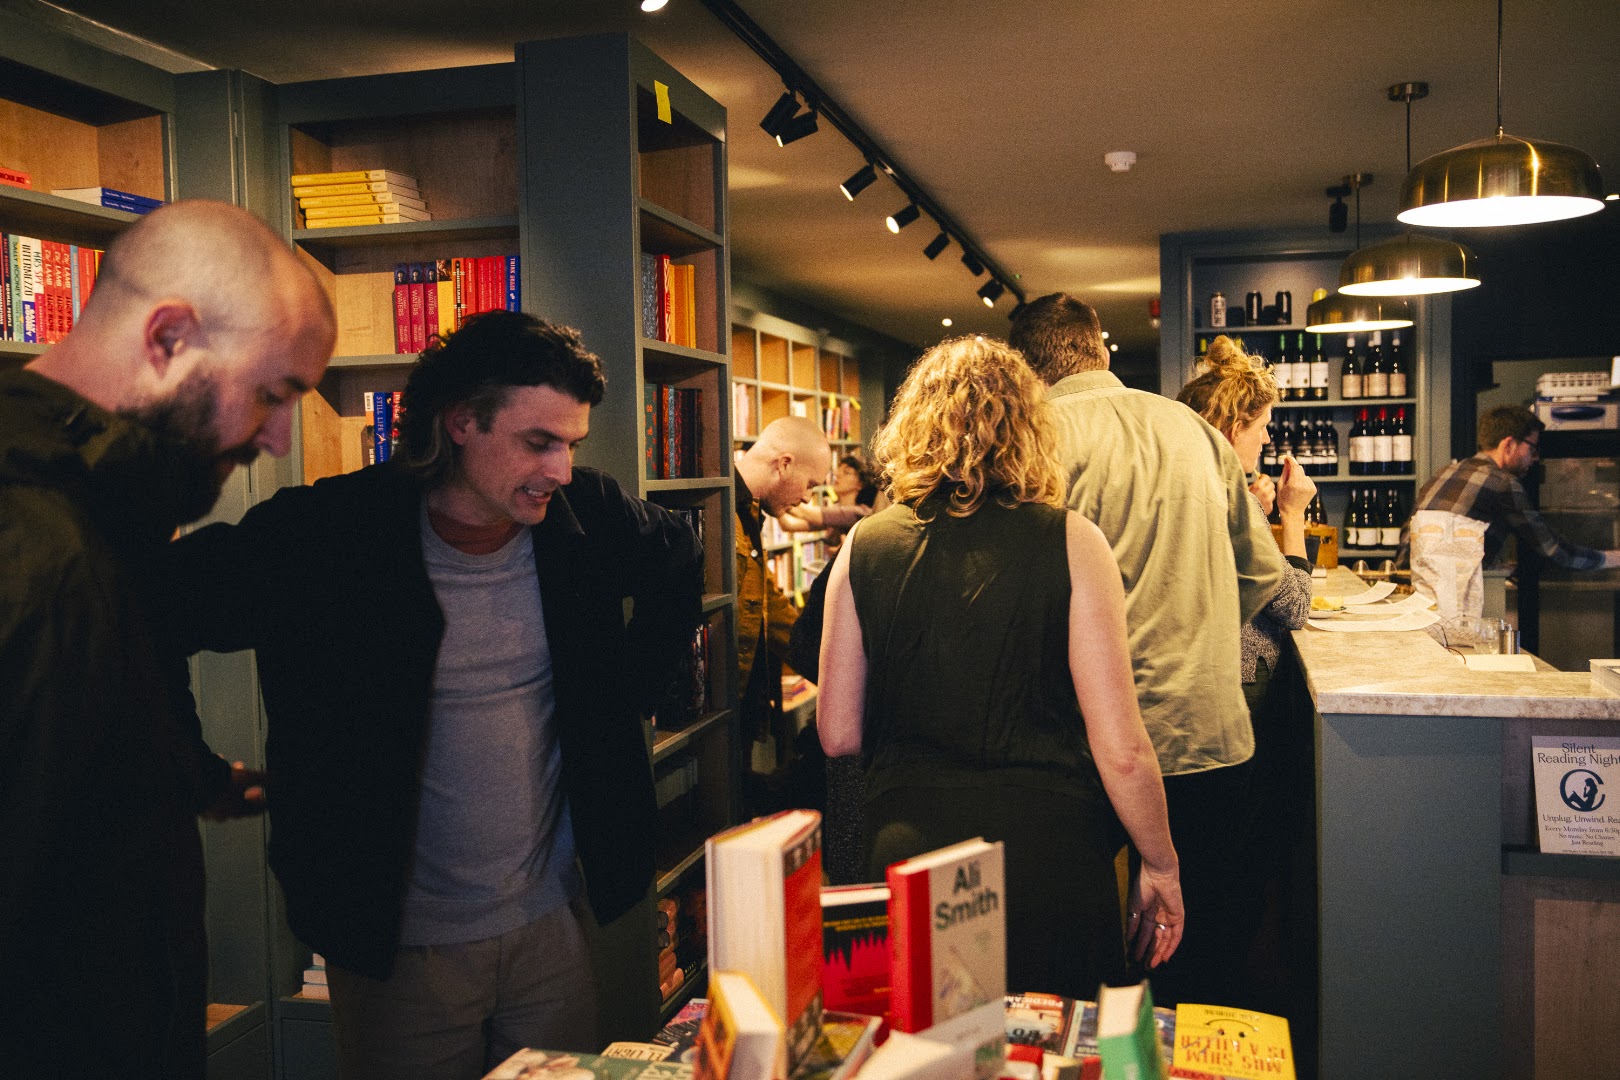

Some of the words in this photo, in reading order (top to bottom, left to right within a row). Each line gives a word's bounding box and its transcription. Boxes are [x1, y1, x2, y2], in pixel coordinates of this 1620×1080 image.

[33, 251, 42, 268] MRS
[22, 244, 33, 296] INTERMEZZO
[34, 270, 43, 285] SPY
[1562, 743, 1596, 753] Silent
[1538, 753, 1586, 766] Reading
[952, 861, 982, 896] Ali
[934, 890, 999, 930] Smith
[1004, 996, 1063, 1008] PREDICAM
